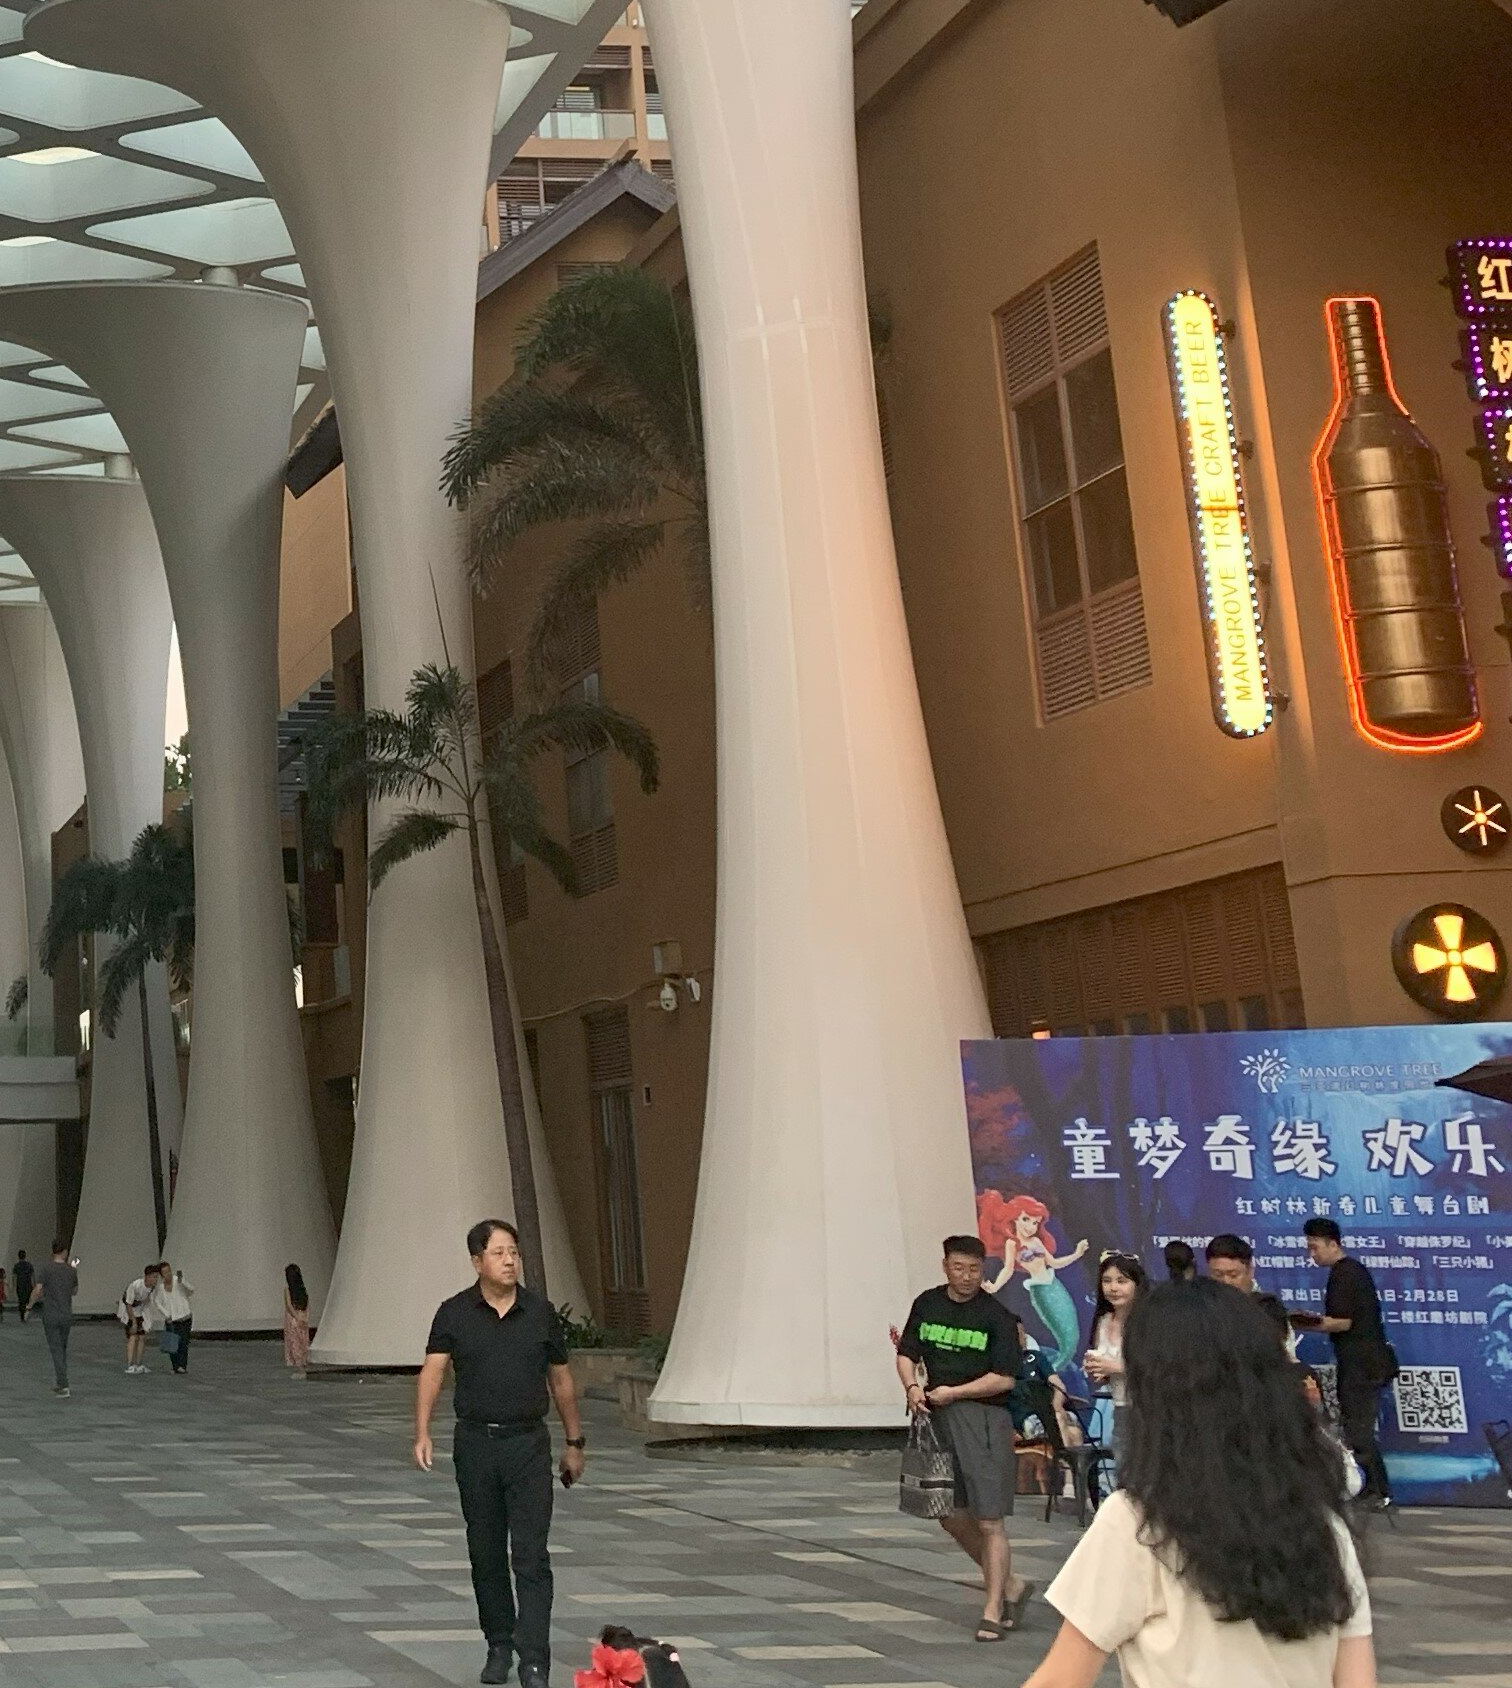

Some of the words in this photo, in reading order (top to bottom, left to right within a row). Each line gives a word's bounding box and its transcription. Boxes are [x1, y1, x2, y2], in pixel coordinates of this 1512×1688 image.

[1185, 320, 1210, 383] BEER
[1196, 399, 1223, 476] CRAFT
[1208, 487, 1233, 551] TREE
[1219, 566, 1253, 702] MANGROVE
[1299, 1065, 1394, 1079] MANGROVE
[1403, 1062, 1442, 1077] TREE
[1063, 1113, 1337, 1181] 童梦奇缘
[1364, 1111, 1506, 1178] 欢乐
[1235, 1194, 1490, 1217] 红树林新春儿童舞台剧
[1381, 1310, 1489, 1325] 二楼红磨坊剧院
